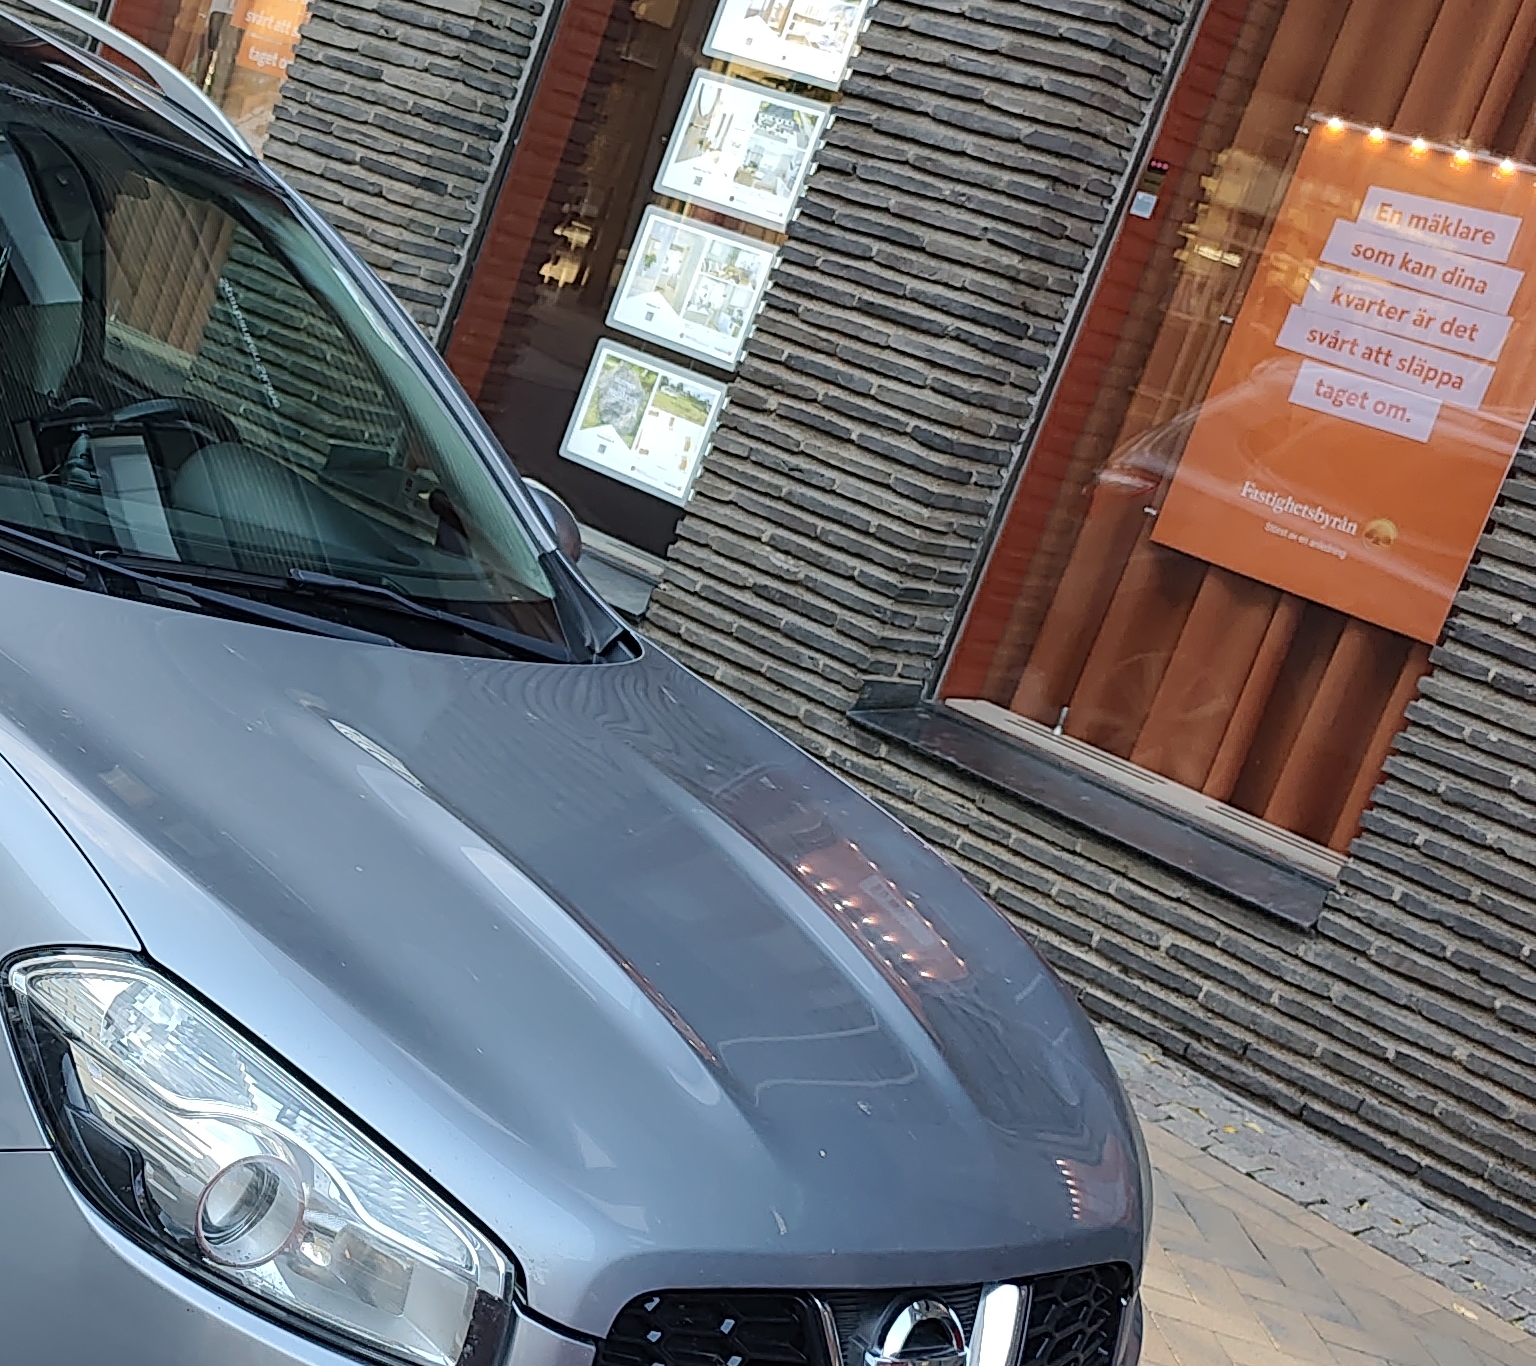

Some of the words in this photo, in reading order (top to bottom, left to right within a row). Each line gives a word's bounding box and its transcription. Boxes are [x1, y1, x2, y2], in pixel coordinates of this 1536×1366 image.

[248, 46, 278, 68] taget
[1376, 202, 1402, 224] En
[1408, 212, 1496, 245] mäklare
[1351, 241, 1395, 267] som
[1399, 251, 1436, 278] kan
[1441, 266, 1488, 295] dina
[1331, 286, 1409, 323] kvarter
[1412, 308, 1436, 330] är
[1440, 316, 1479, 342] det
[1307, 327, 1359, 356] svårt
[1361, 343, 1392, 367] att
[1396, 354, 1464, 391] släppa
[1315, 378, 1369, 410] taget
[1373, 399, 1411, 423] om.
[1240, 481, 1358, 535] Fastighetsbyrån
